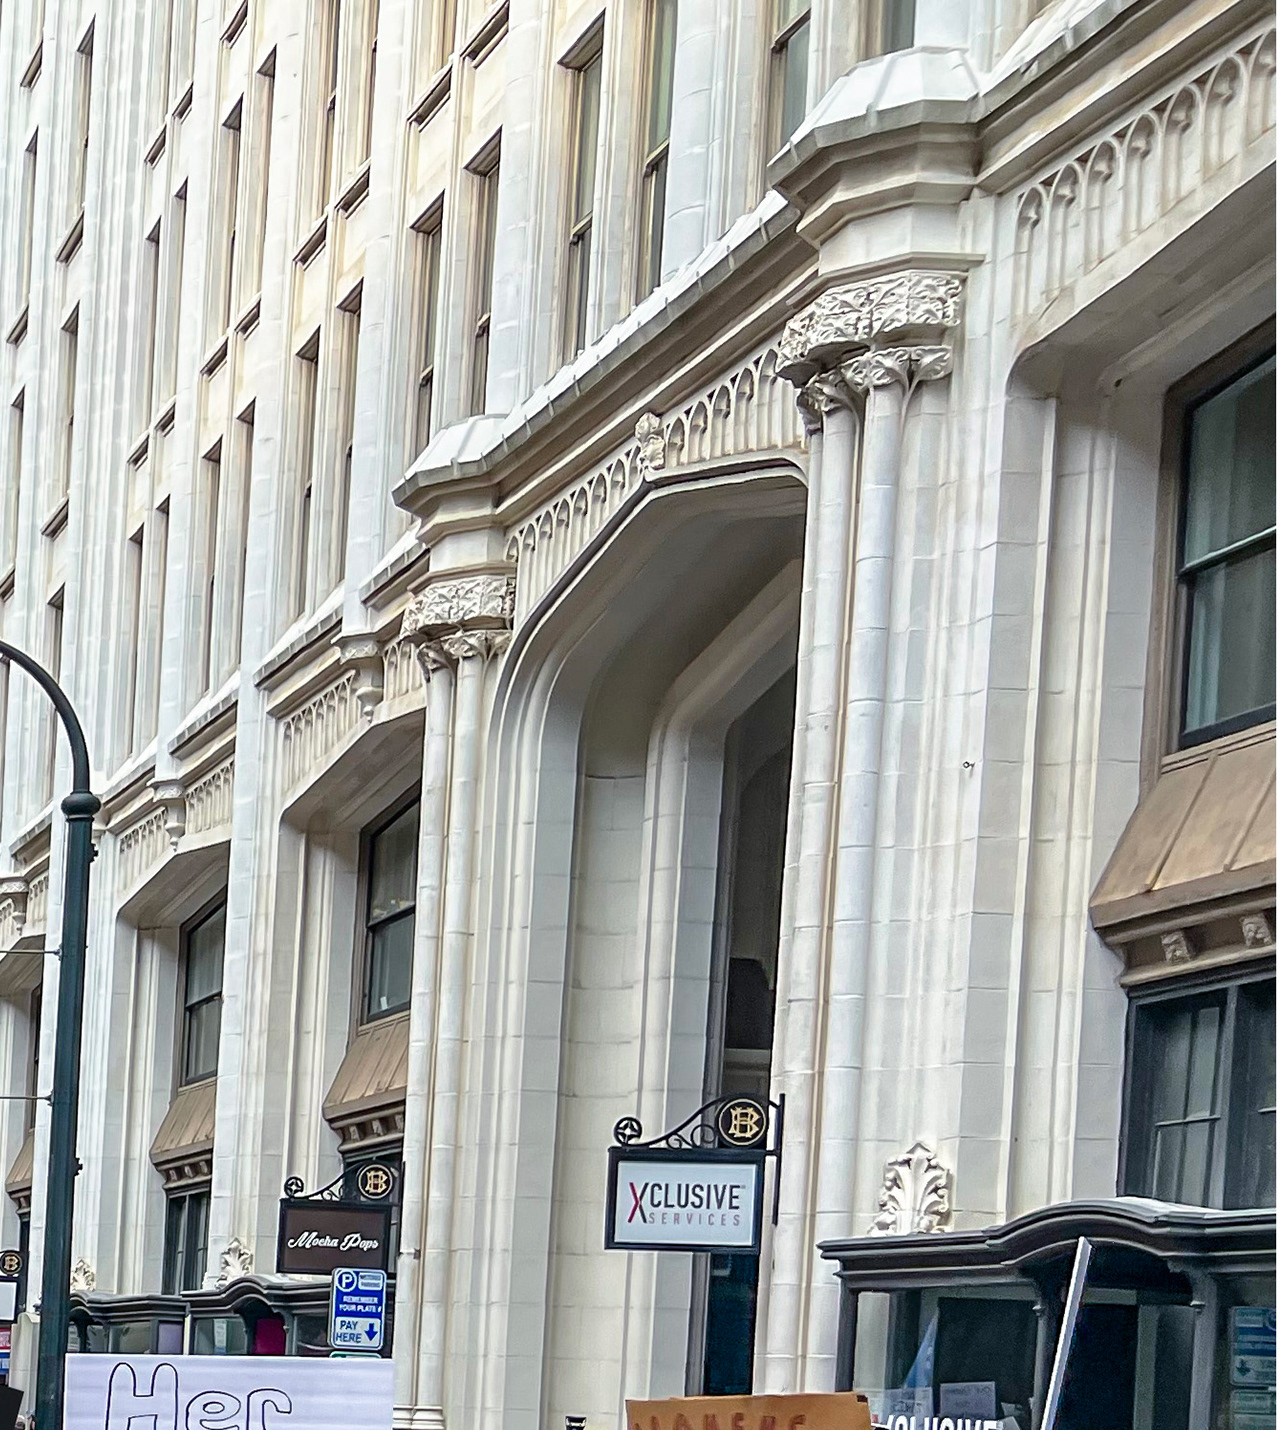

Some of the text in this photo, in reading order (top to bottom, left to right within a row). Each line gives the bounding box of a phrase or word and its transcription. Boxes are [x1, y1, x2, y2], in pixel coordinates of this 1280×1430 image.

[627, 1181, 742, 1223] XCLUSIVE
[648, 1213, 740, 1226] SERVICES
[287, 1231, 379, 1251] Mocha Pops
[342, 1273, 353, 1288] P
[340, 1320, 359, 1330] PAY
[336, 1332, 362, 1344] HERE
